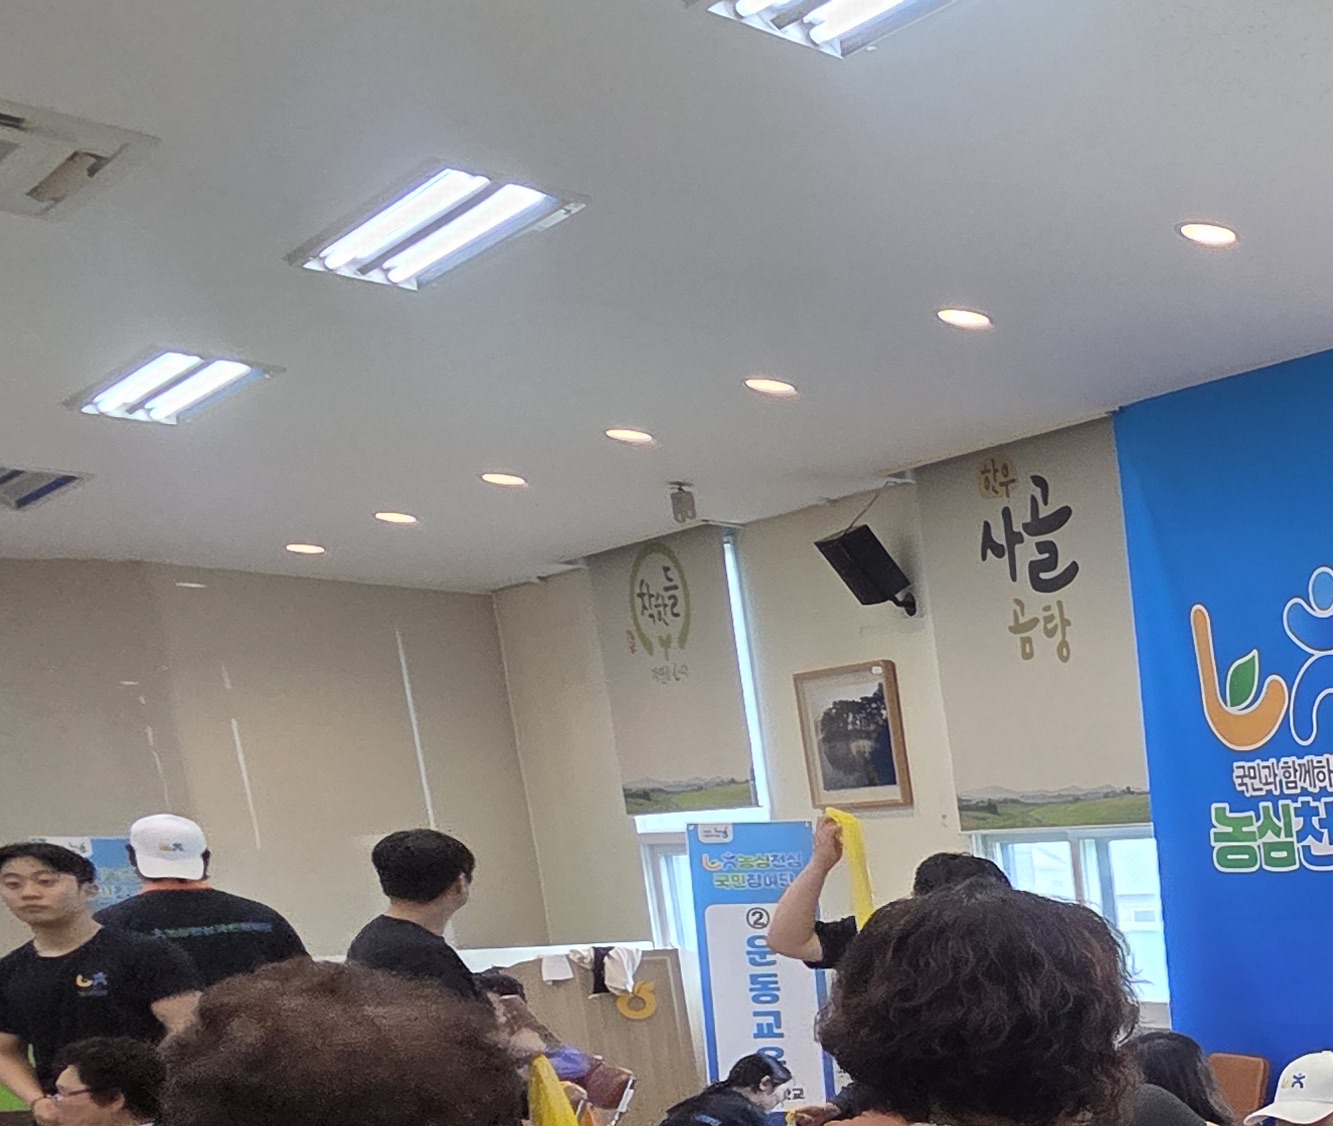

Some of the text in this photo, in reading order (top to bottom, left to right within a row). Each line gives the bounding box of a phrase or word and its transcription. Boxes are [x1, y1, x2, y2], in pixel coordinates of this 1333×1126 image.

[979, 458, 1016, 499] 한우
[981, 474, 1079, 593] 사골
[636, 566, 680, 626] 착한들
[1008, 598, 1072, 663] 곰탕
[1233, 759, 1280, 796] 국민과
